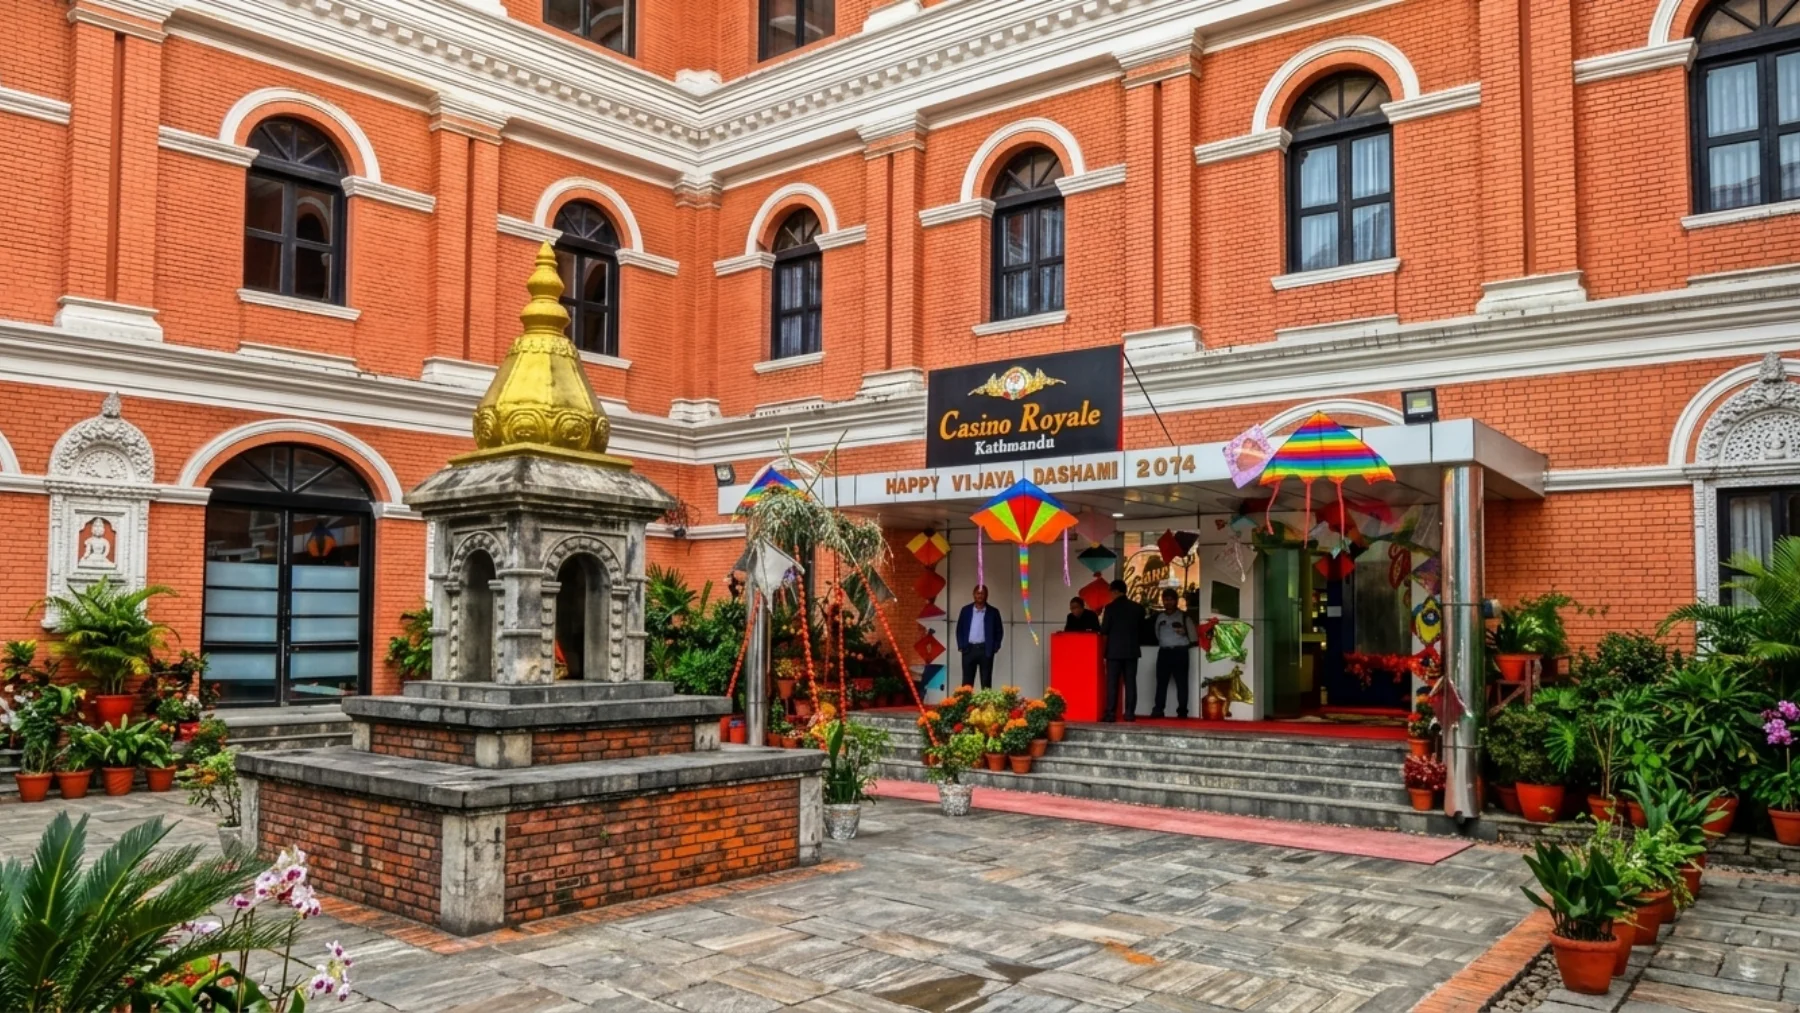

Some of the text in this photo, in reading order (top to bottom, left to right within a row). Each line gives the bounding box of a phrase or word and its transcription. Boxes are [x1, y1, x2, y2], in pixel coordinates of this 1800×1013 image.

[939, 400, 1101, 440] Casino Royale
[975, 433, 1055, 455] Kathmandu
[885, 454, 1196, 495] HAPPY VIJAYA DASHAMI 2074
